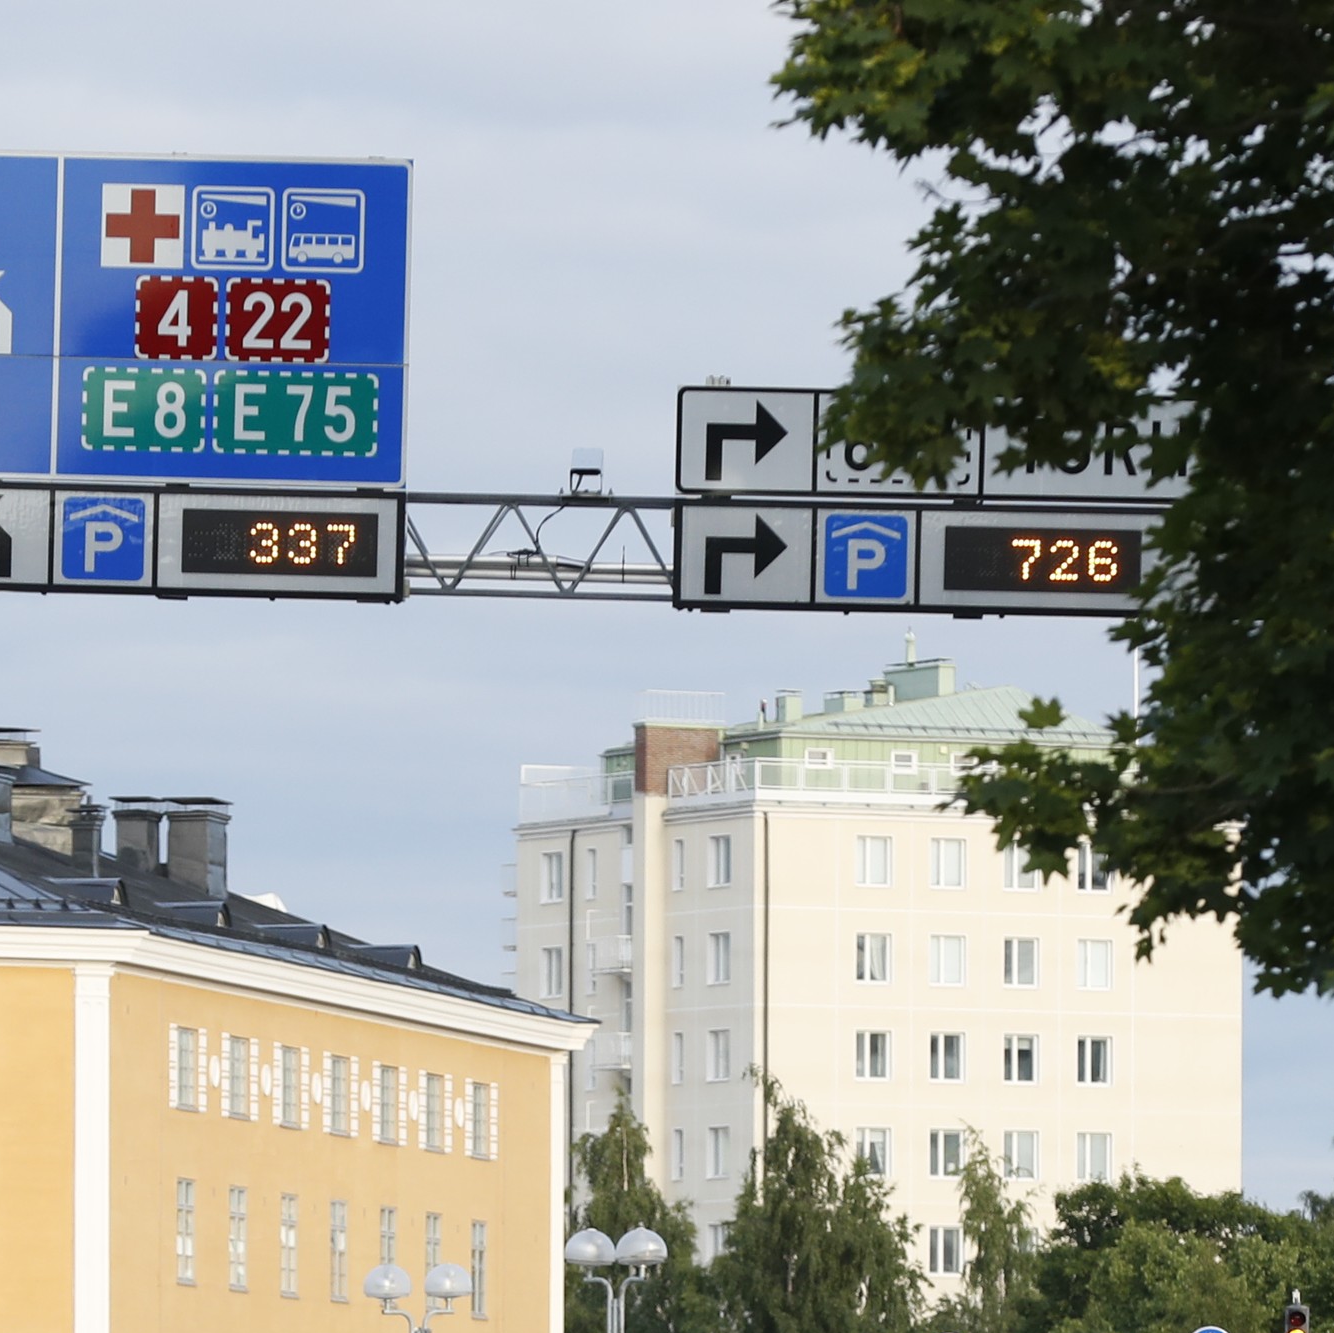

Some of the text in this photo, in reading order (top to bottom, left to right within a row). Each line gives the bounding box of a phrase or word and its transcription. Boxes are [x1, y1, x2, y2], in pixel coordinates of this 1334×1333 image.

[157, 289, 192, 347] 4
[242, 291, 313, 350] 22
[102, 379, 186, 439] E 8
[233, 383, 356, 443] E 75
[84, 520, 124, 573] P
[249, 522, 356, 565] 337
[846, 538, 886, 591] P
[1011, 538, 1118, 582] 726
